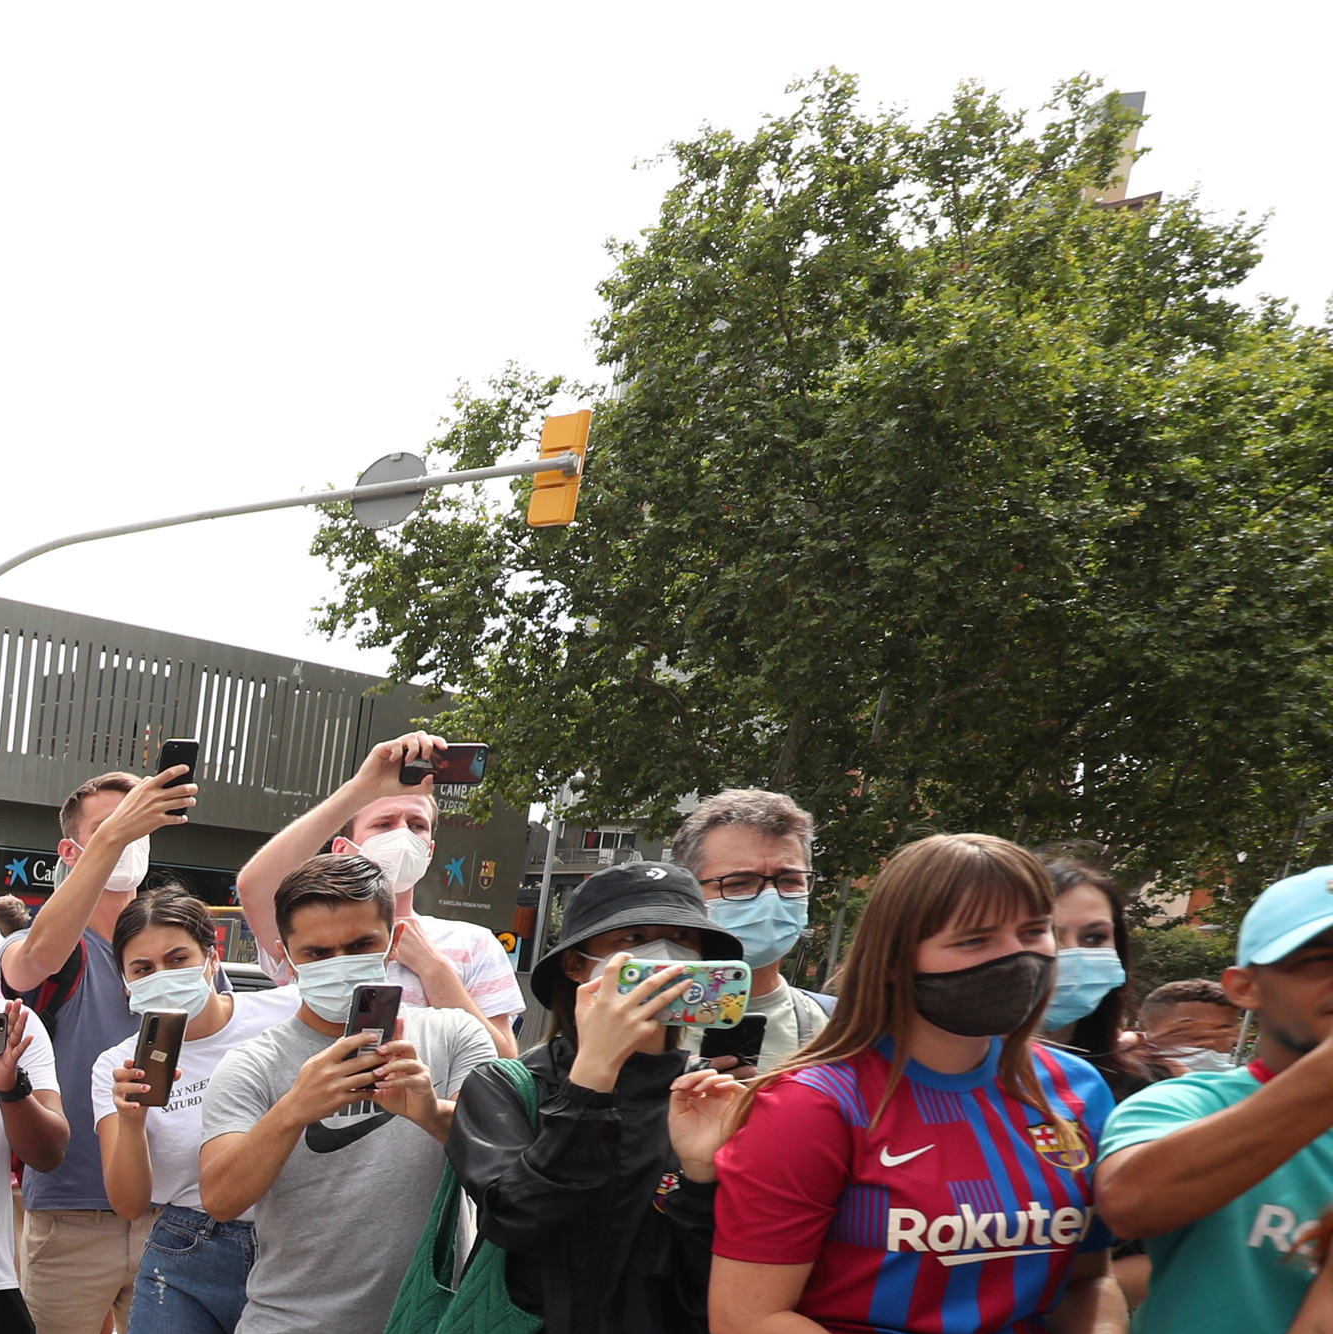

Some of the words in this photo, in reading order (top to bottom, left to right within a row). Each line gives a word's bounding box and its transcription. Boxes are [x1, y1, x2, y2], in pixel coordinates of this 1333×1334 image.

[33, 860, 55, 881] Cai
[185, 1078, 210, 1095] NEE
[161, 1095, 202, 1113] SATURD
[1248, 1204, 1321, 1256] Ra
